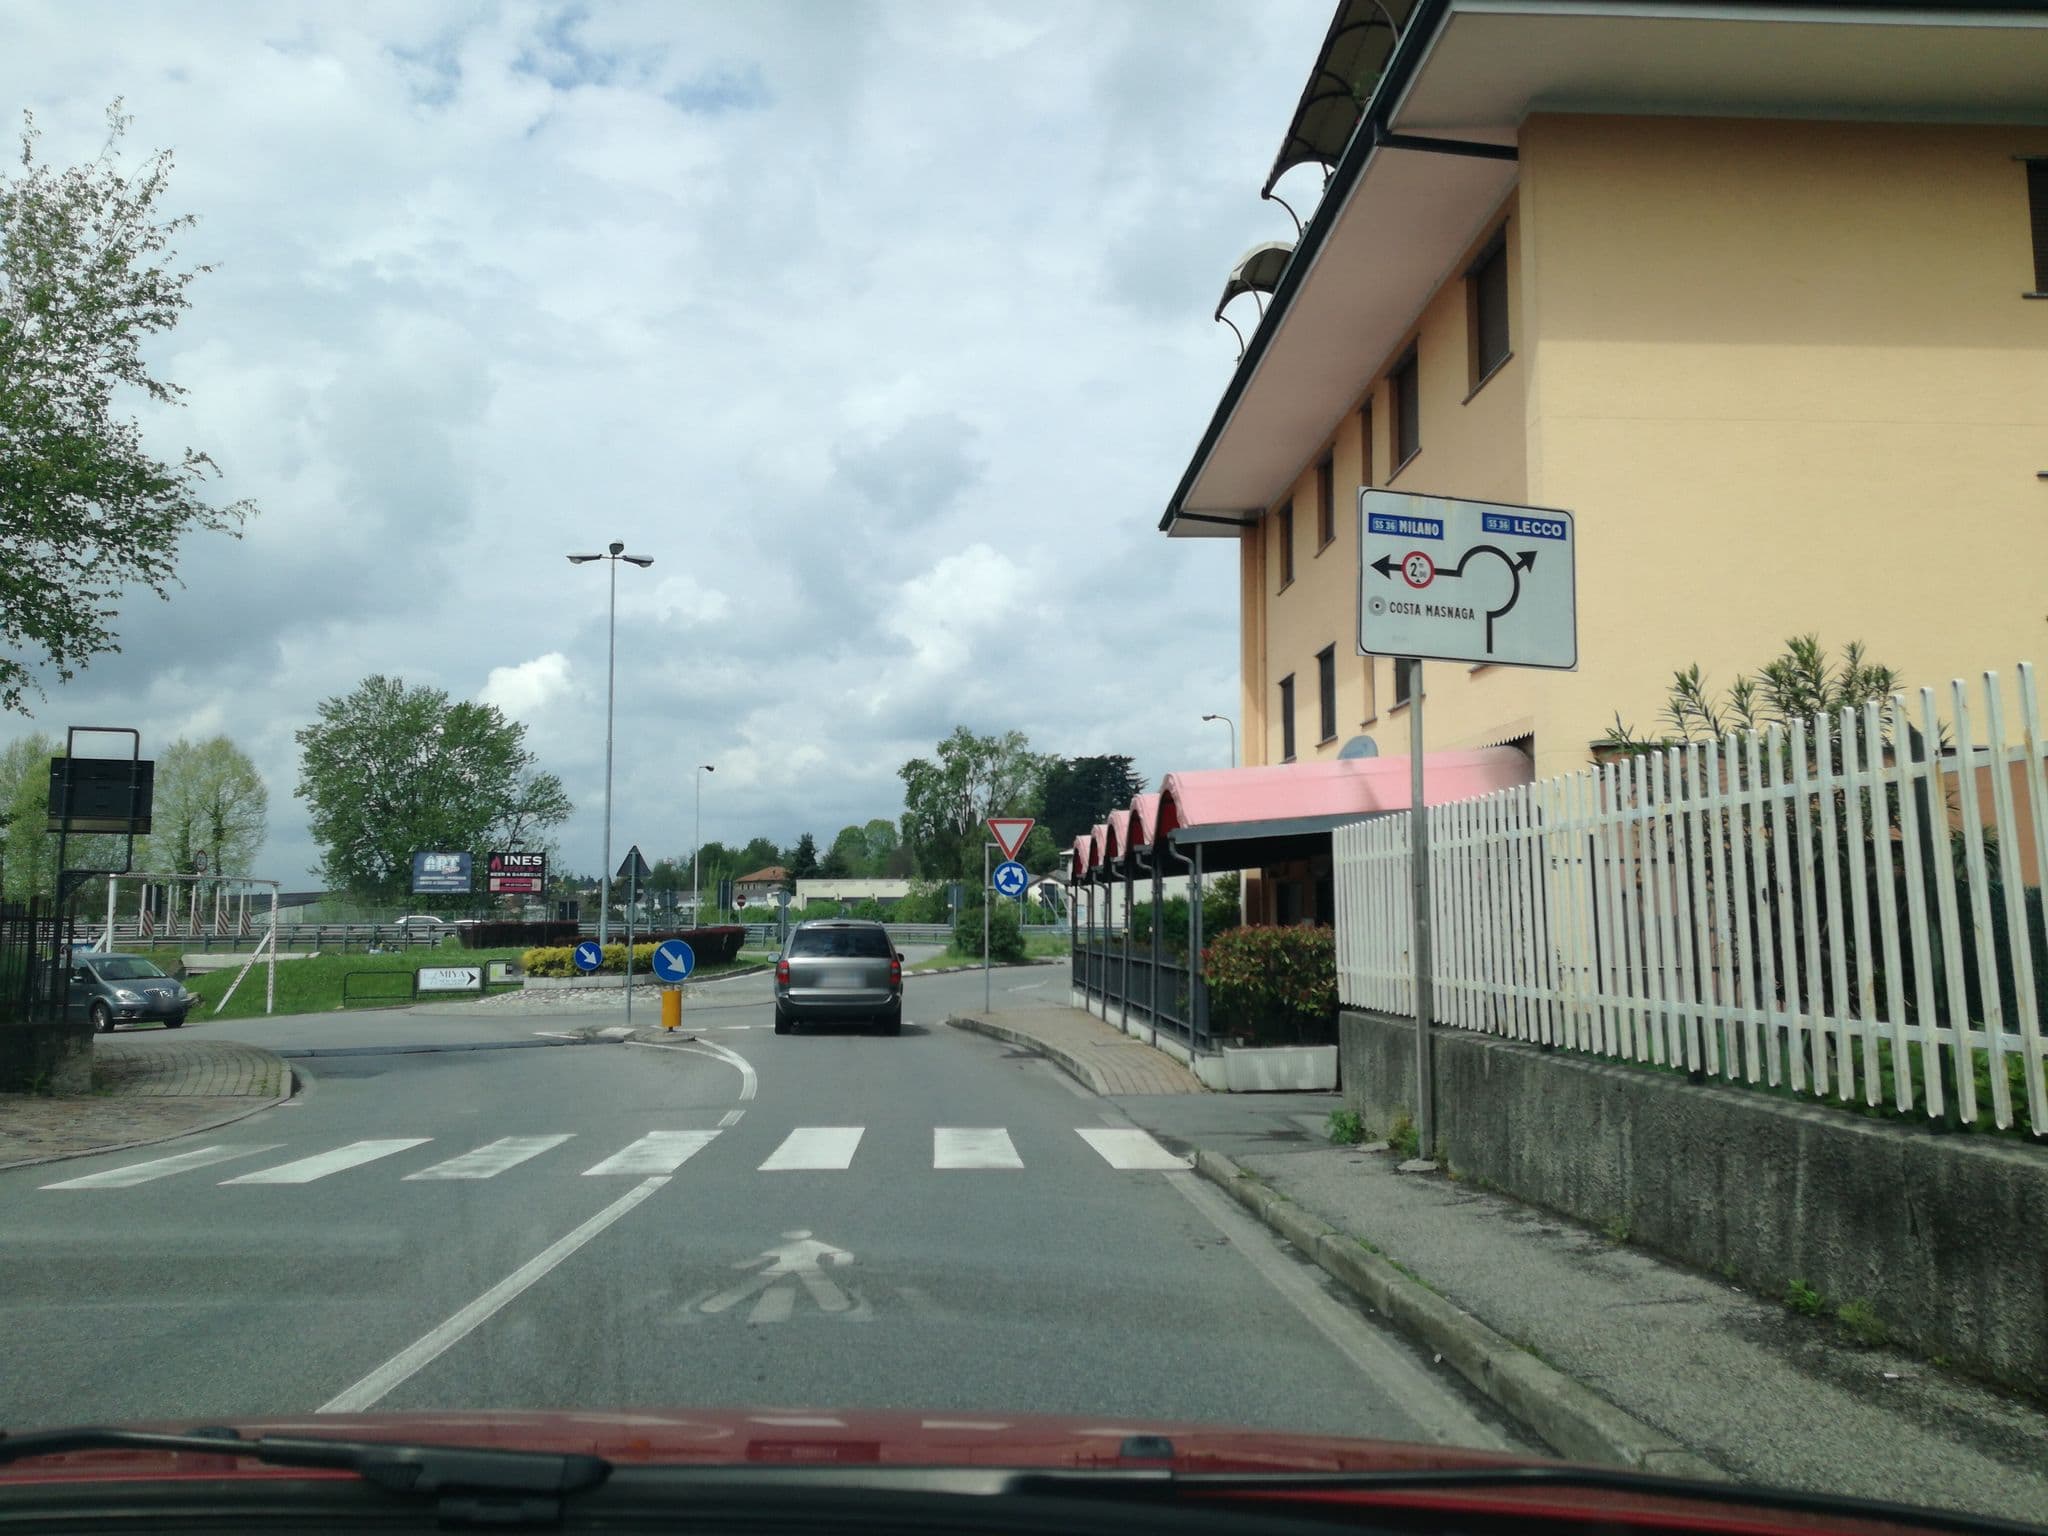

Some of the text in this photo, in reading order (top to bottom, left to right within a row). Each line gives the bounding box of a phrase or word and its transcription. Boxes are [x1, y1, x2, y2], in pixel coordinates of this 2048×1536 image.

[1374, 519, 1384, 529] SS
[1399, 519, 1440, 537] MILANO
[1514, 519, 1562, 537] LECCO
[1389, 601, 1475, 620] COSTA MASNAGA
[504, 855, 543, 866] INES
